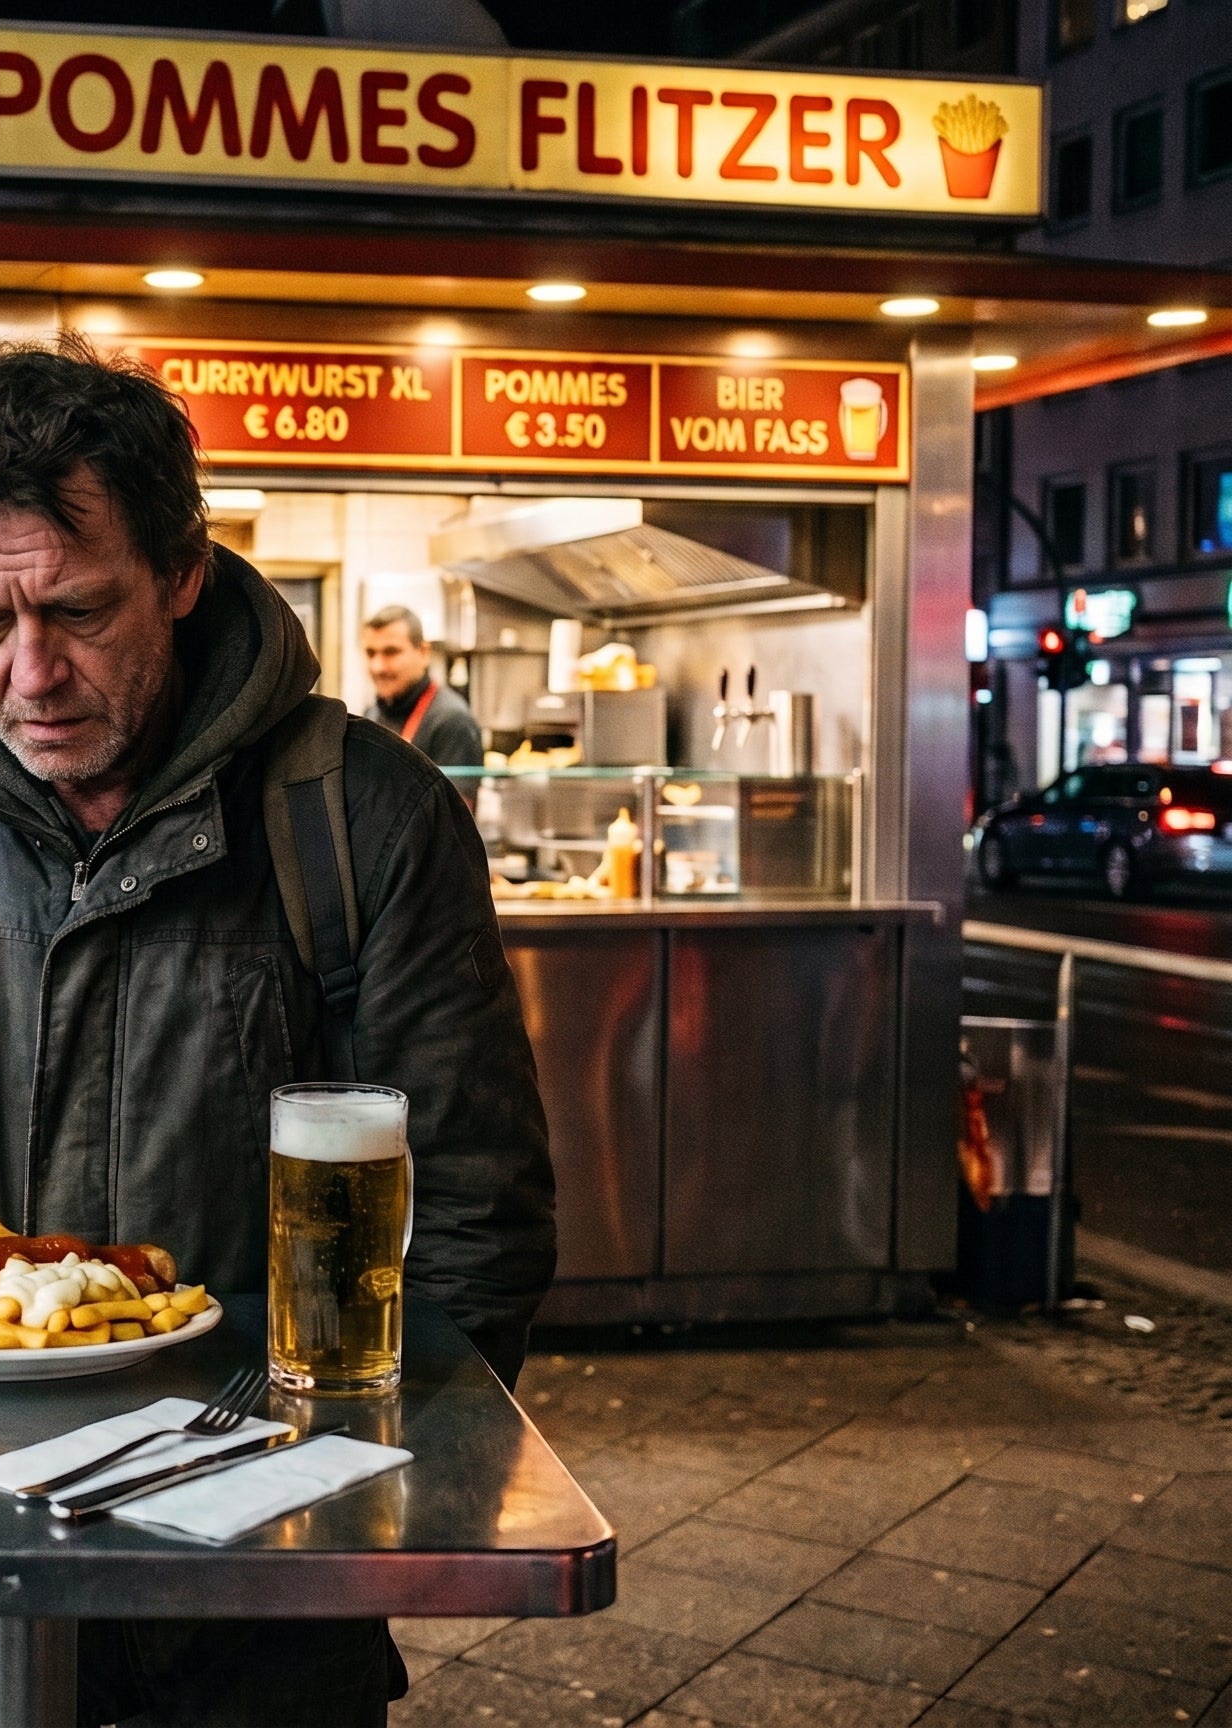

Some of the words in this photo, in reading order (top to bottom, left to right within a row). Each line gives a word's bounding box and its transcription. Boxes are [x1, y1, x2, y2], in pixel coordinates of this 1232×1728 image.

[520, 79, 901, 188] FLITZER
[163, 358, 383, 399] CURRYWURST
[389, 366, 432, 401] XL
[485, 369, 628, 407] POMMES
[717, 376, 786, 411] BIER
[243, 404, 269, 439] €
[274, 405, 349, 442] 6.80
[504, 411, 530, 448] €
[535, 412, 607, 449] 3.50
[670, 417, 747, 452] VOM
[753, 418, 829, 455] FASS
